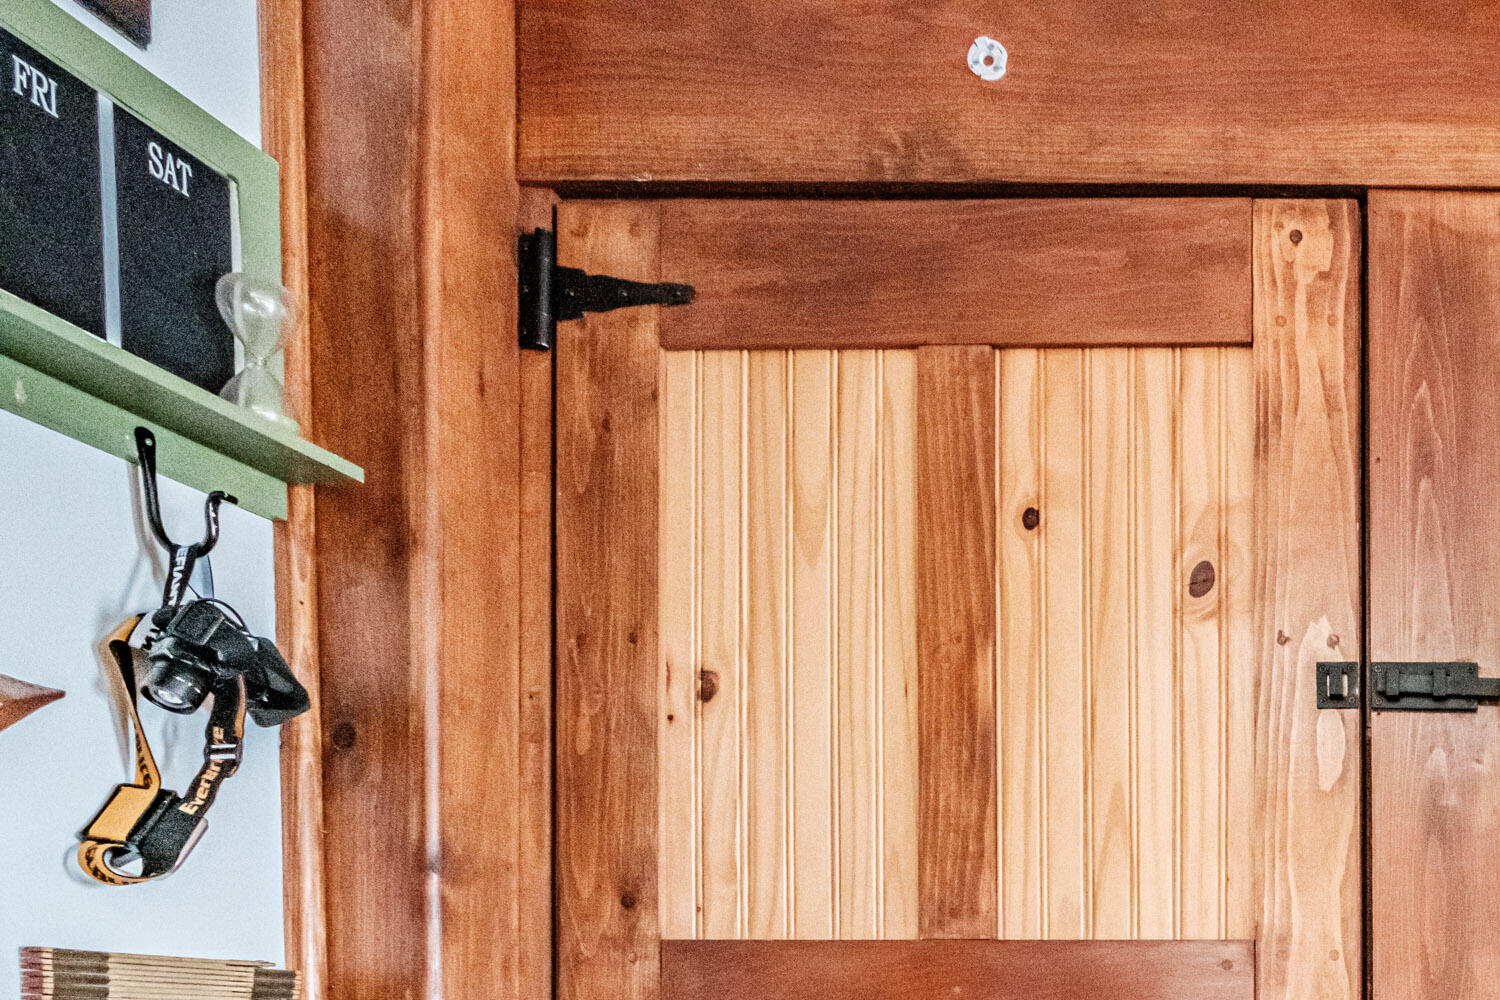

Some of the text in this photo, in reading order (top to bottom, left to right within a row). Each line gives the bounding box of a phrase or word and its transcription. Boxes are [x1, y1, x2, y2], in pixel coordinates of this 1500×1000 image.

[12, 55, 59, 118] FRI
[147, 141, 193, 198] SAT
[178, 726, 225, 815] Everbrie
